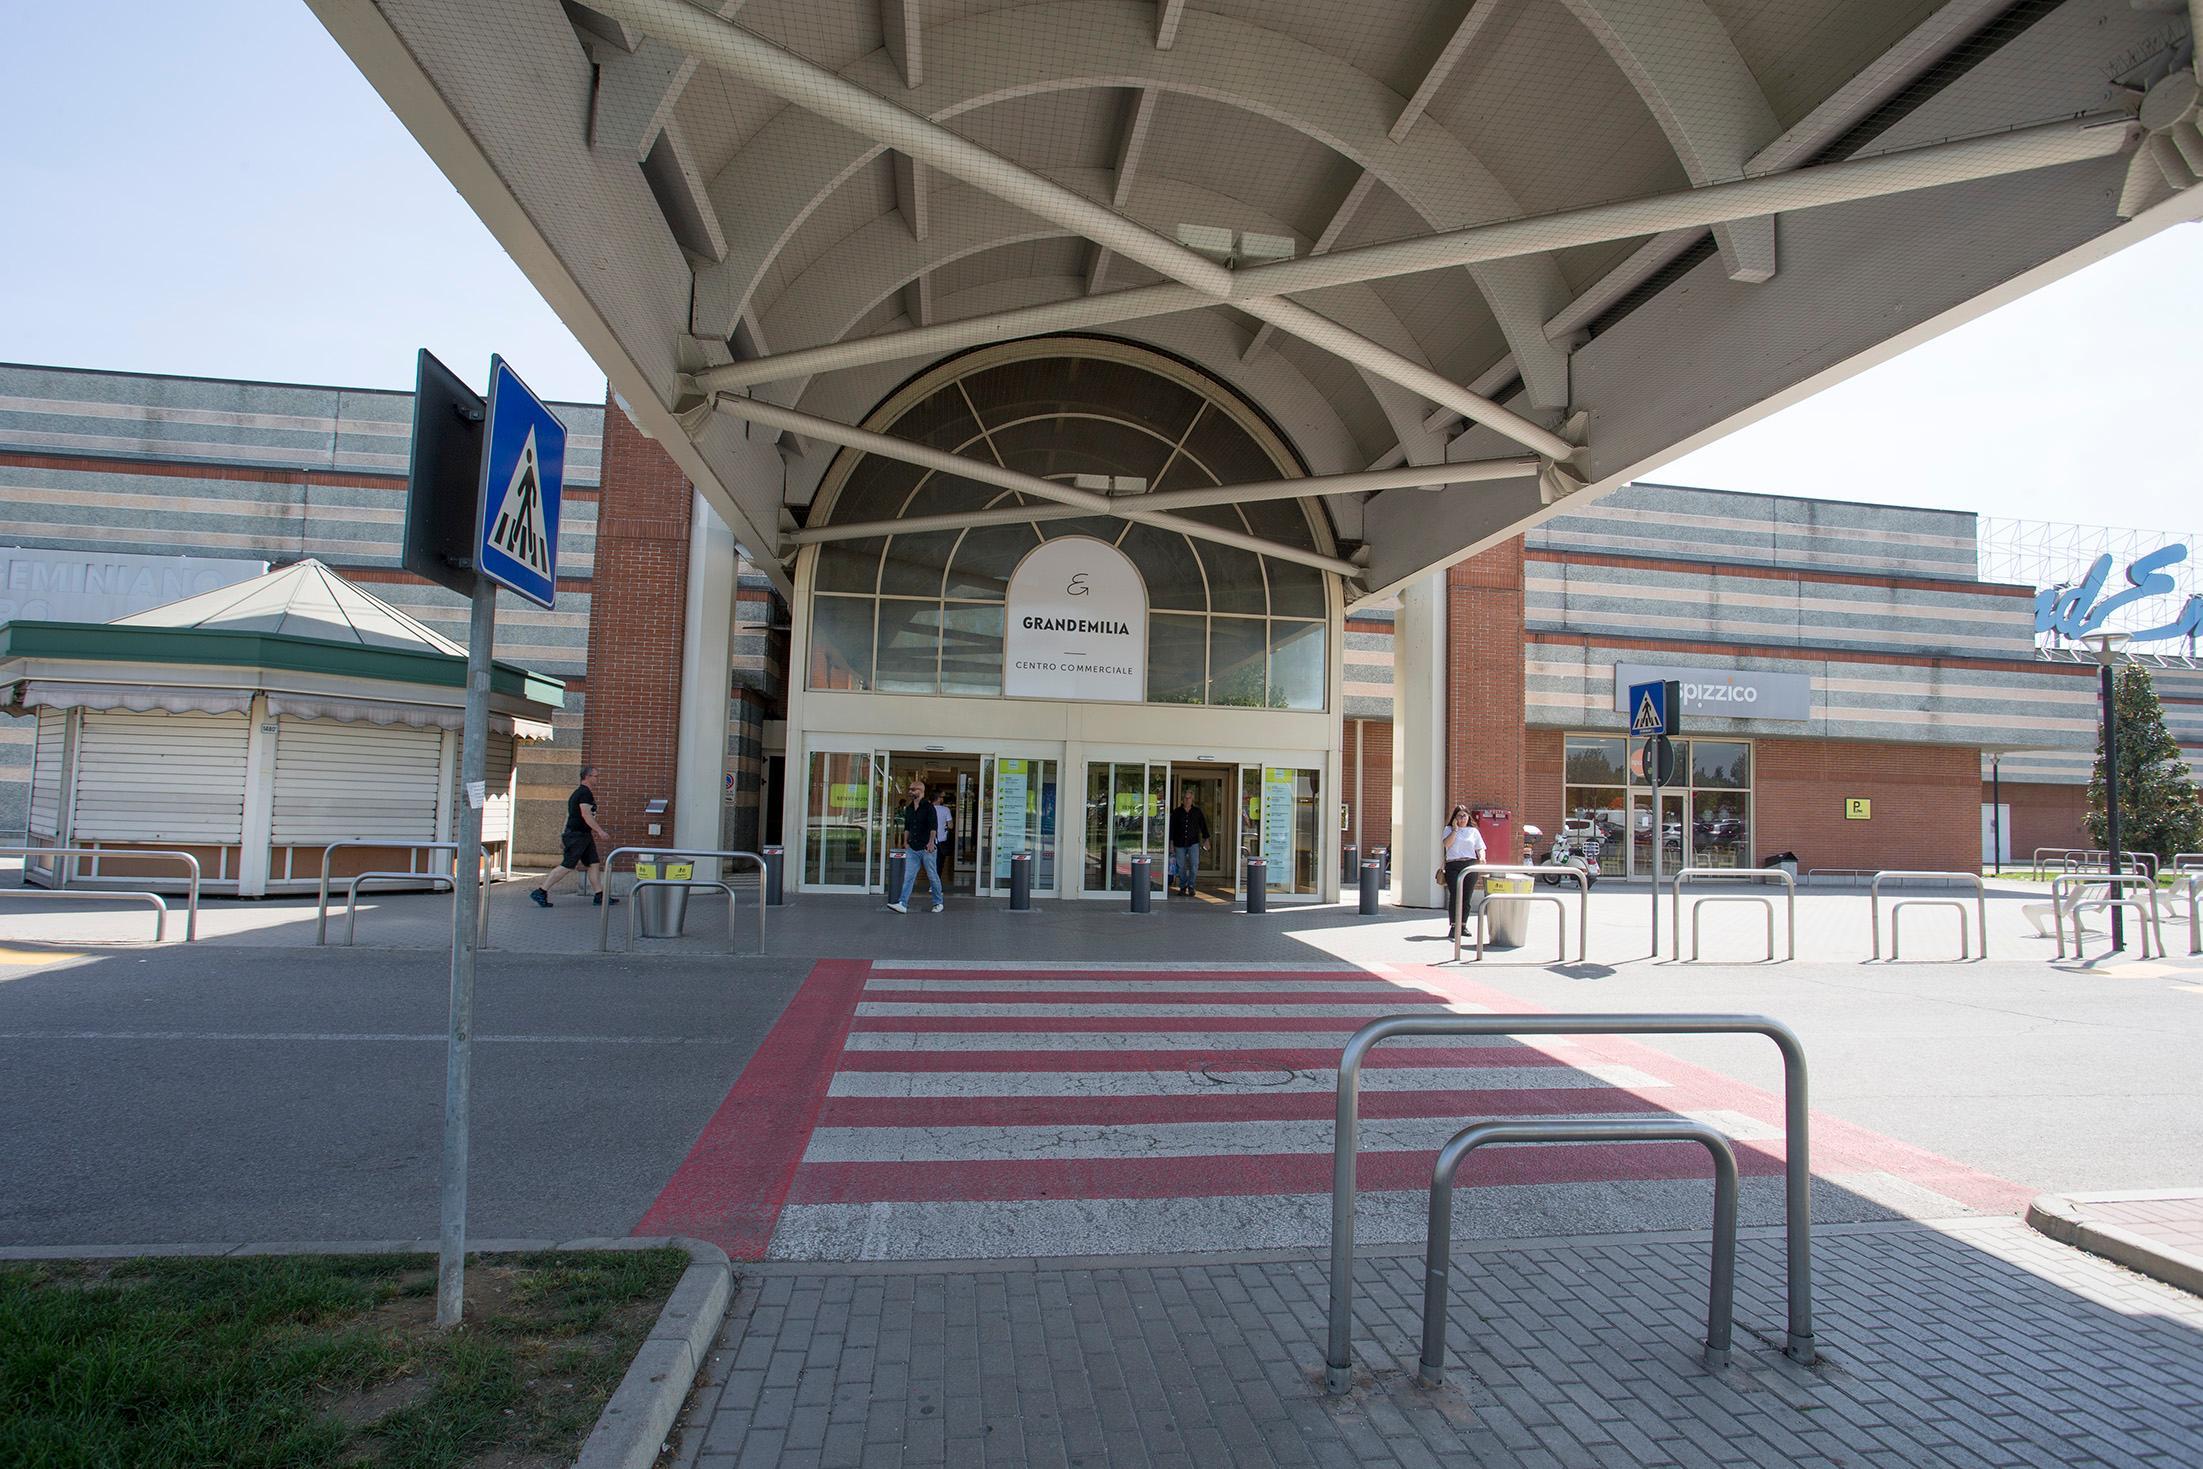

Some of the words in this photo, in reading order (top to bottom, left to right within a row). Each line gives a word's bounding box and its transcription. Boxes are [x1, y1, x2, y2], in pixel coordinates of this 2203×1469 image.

[1023, 616, 1130, 635] GRANDEMILIA
[1016, 661, 1057, 671] CENTRO
[1060, 663, 1133, 675] COMMERCIALE
